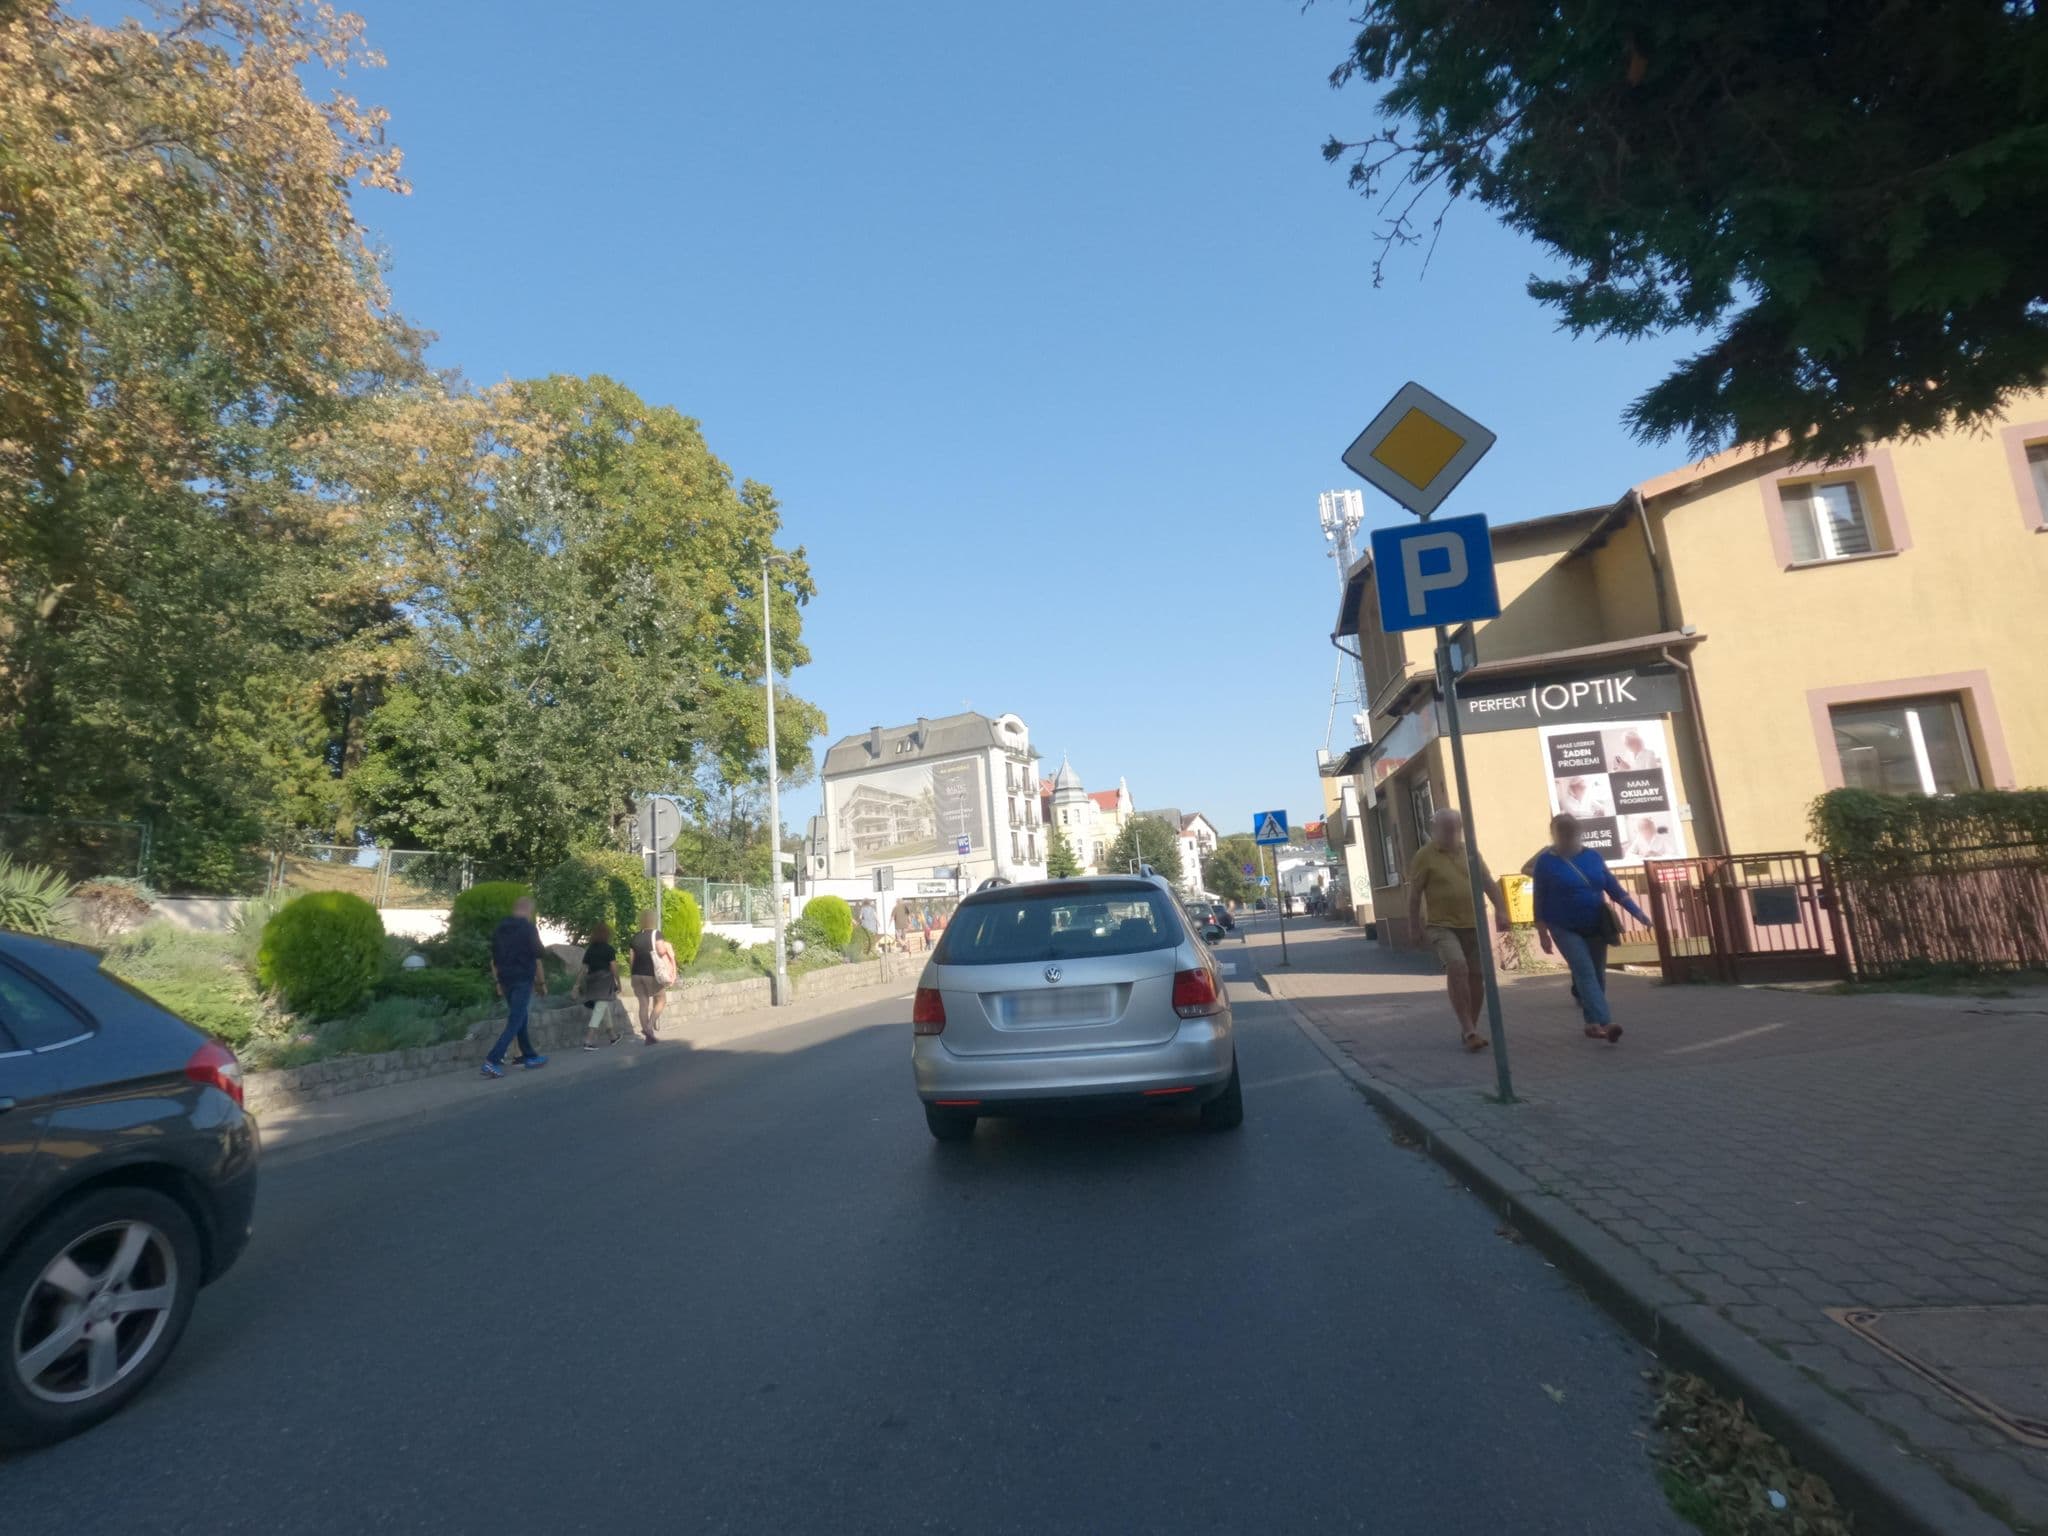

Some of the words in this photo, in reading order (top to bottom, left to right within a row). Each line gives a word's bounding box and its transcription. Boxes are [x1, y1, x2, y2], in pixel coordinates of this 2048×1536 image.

[1401, 531, 1468, 616] P
[1469, 695, 1526, 713] PERFEKT
[1541, 676, 1638, 711] OPTIK
[1620, 787, 1659, 798] OKULARY
[1627, 779, 1650, 788] MAM
